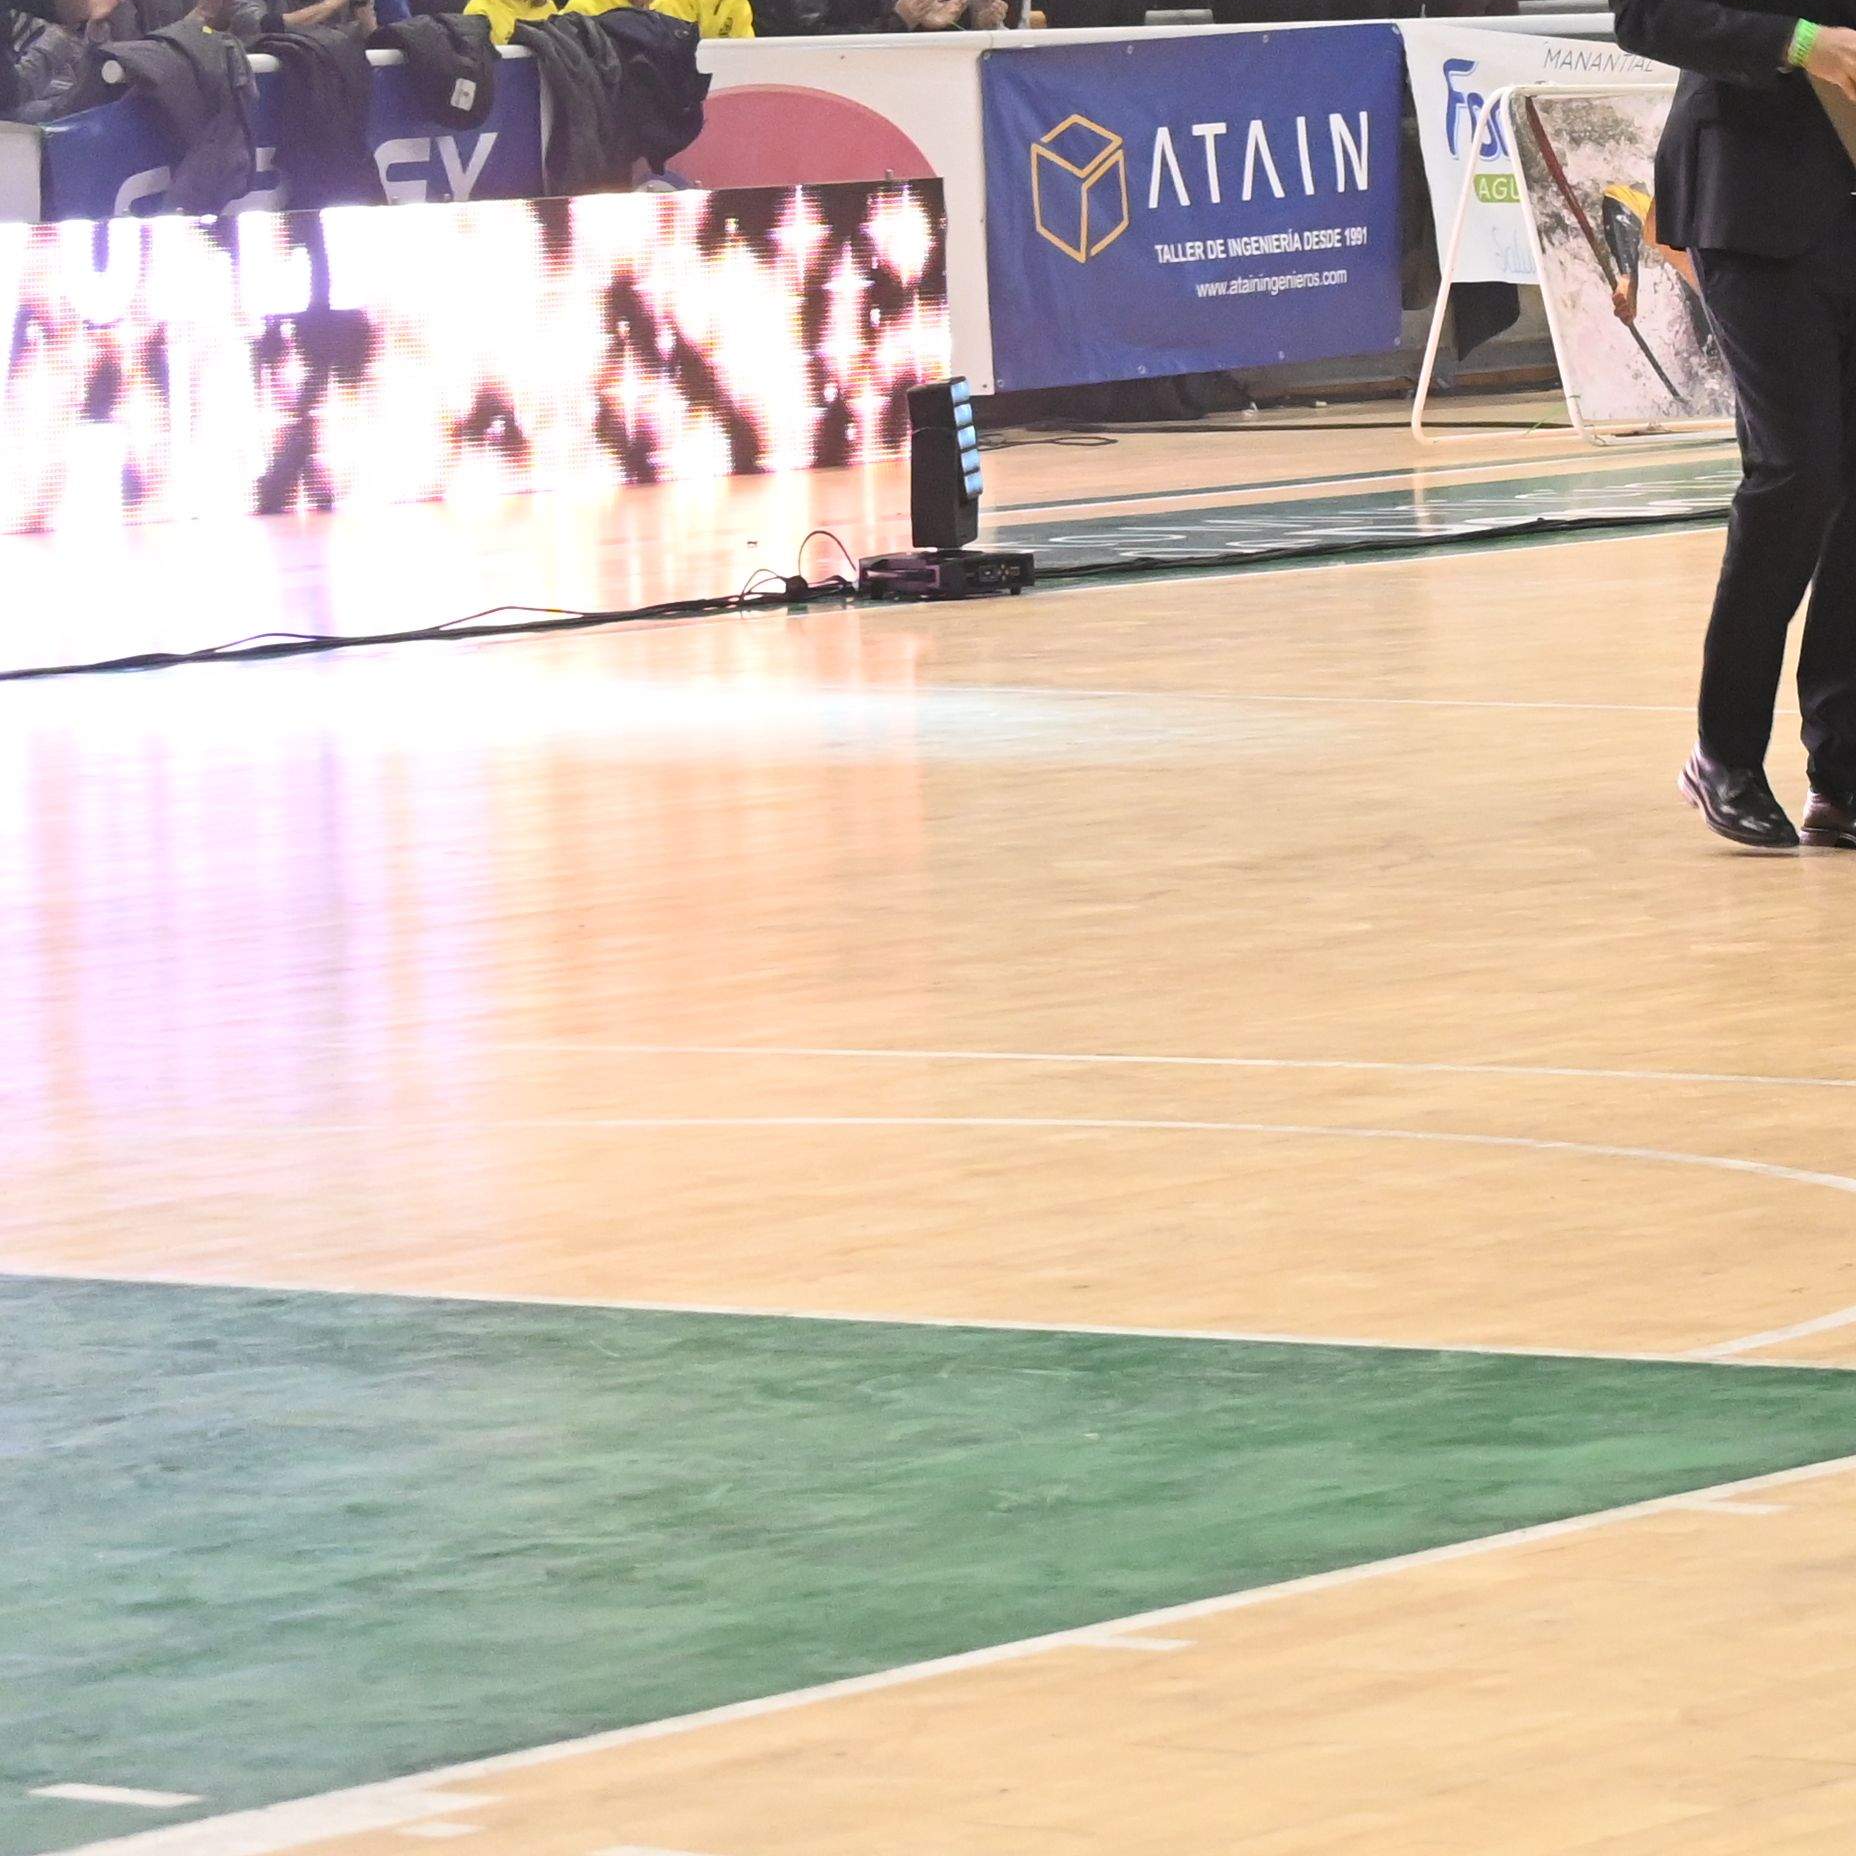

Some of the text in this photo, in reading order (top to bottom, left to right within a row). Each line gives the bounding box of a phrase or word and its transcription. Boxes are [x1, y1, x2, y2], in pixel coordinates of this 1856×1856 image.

[1543, 47, 1653, 74] MANANTIAL
[1148, 111, 1369, 209] ATAIN
[1154, 226, 1368, 264] TALLER DE INGENIERÍA DESDE 1991
[1196, 268, 1348, 298] www.atainingenieros.com
